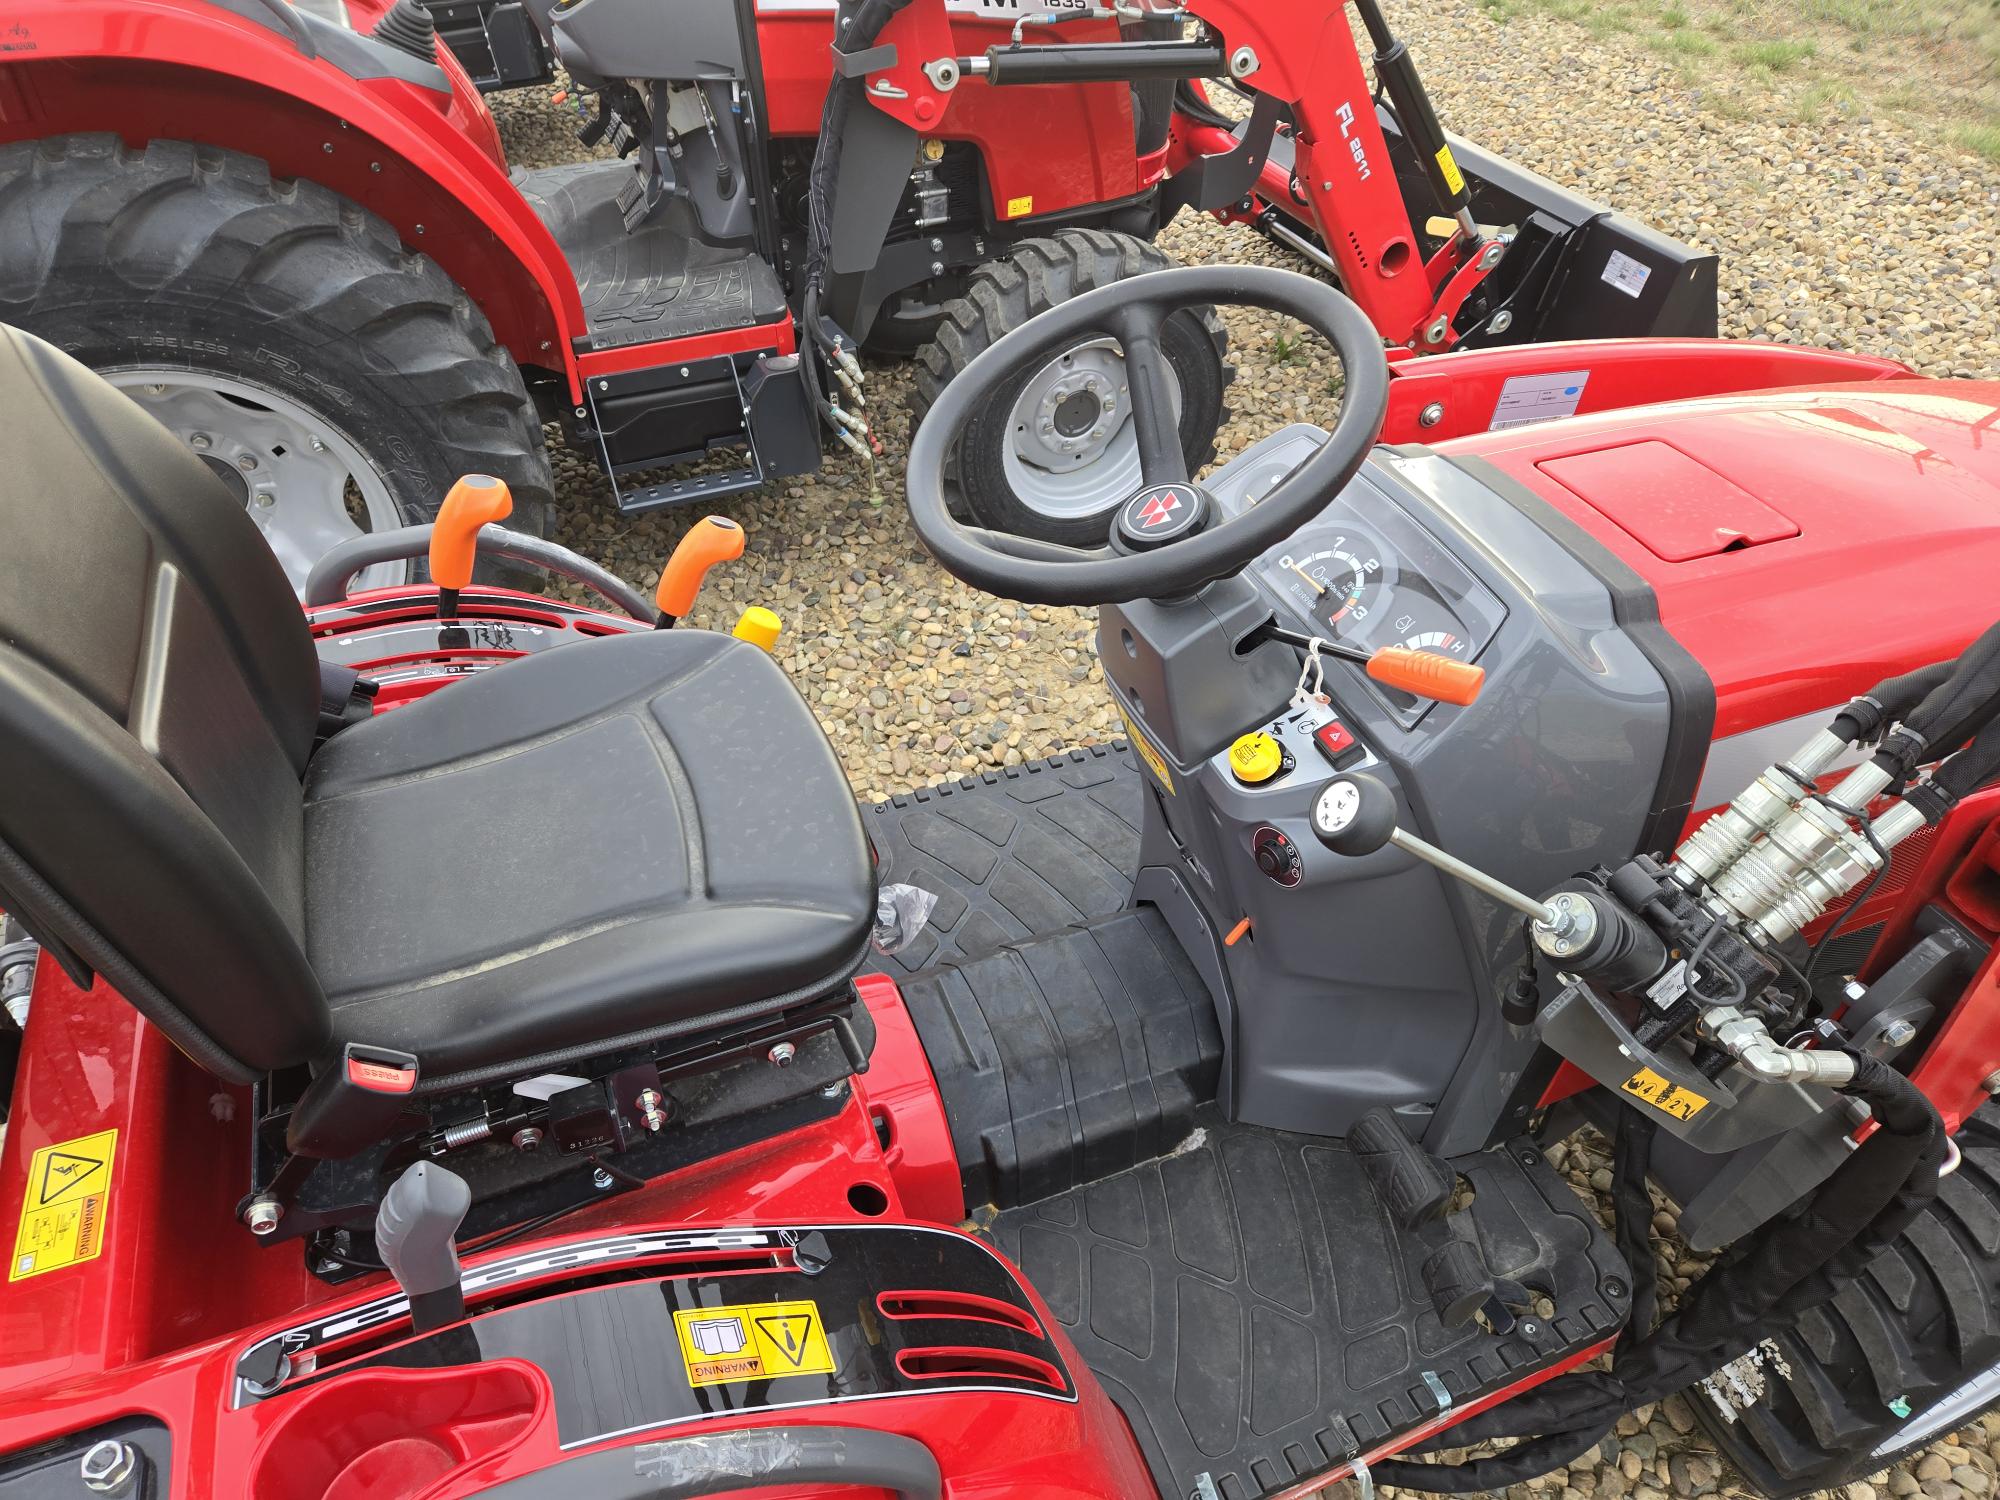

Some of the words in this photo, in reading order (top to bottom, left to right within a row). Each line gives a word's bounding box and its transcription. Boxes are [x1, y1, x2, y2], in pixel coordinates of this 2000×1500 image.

[1335, 101, 1355, 139] FL
[1349, 136, 1371, 181] 2611
[1334, 536, 1346, 548] 1
[1278, 555, 1294, 570] 0
[1362, 558, 1380, 574] 2
[1351, 605, 1369, 621] 3
[493, 624, 504, 632] N
[1450, 640, 1465, 654] H
[79, 1205, 97, 1256] WARNING
[695, 1362, 751, 1377] WARNING
